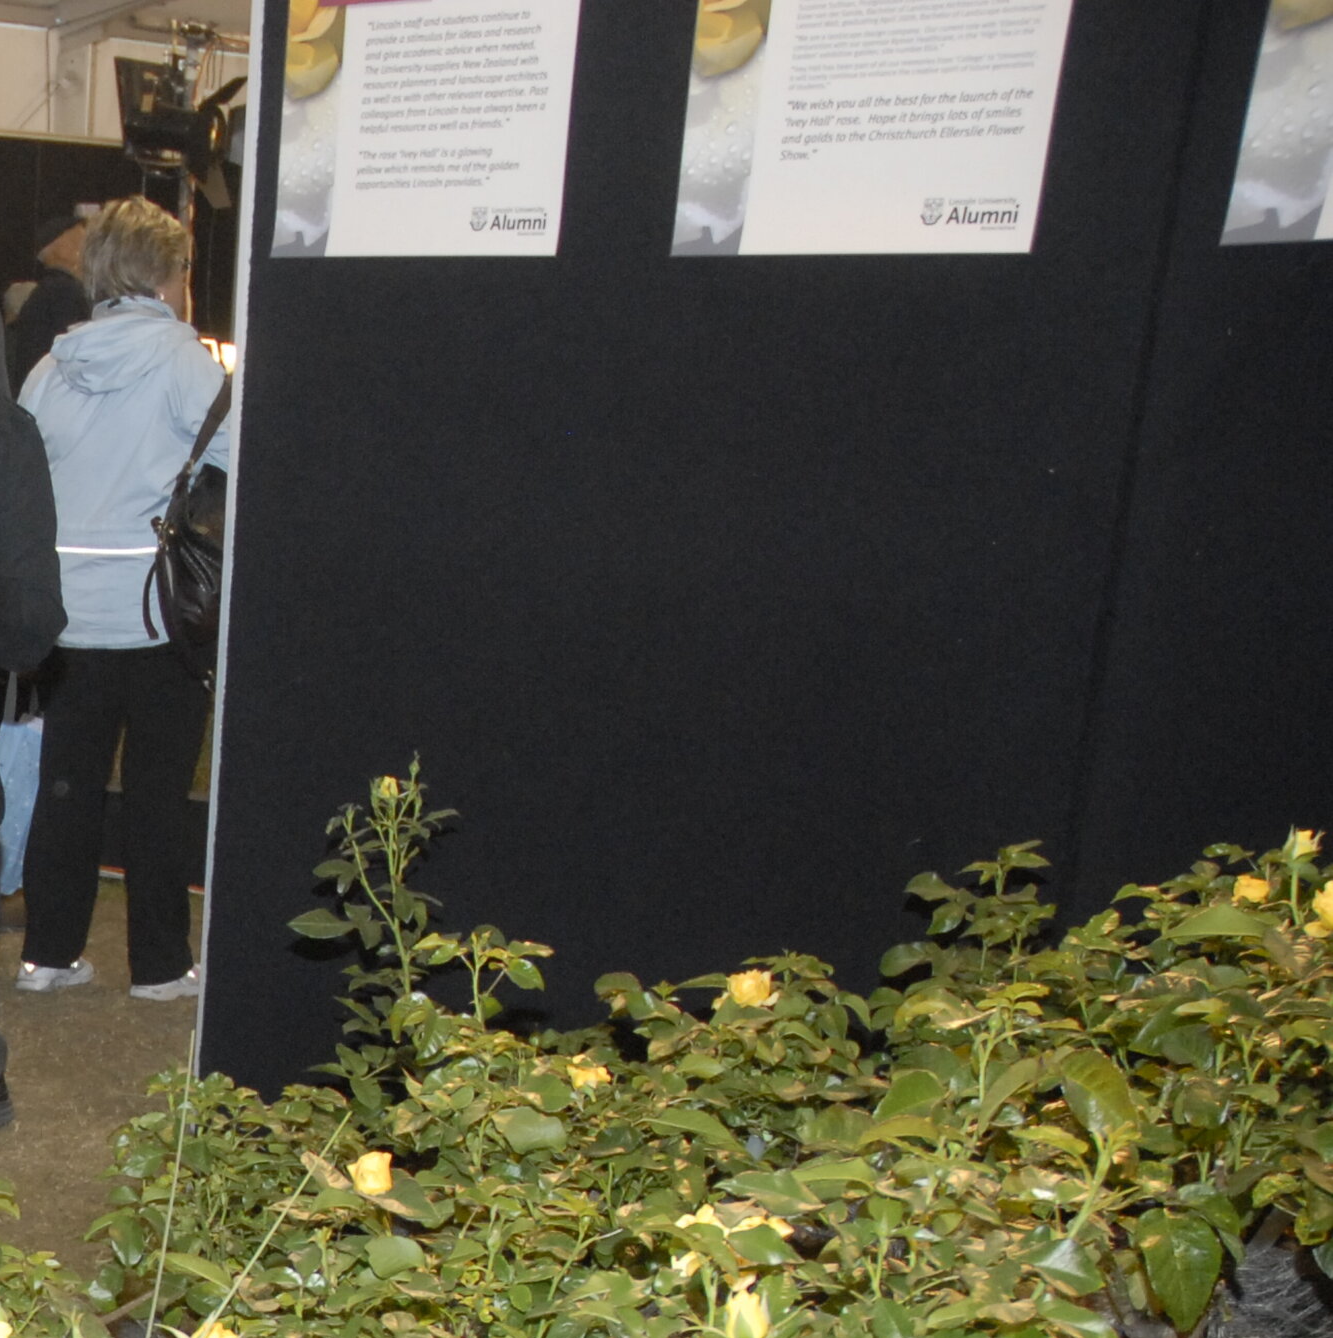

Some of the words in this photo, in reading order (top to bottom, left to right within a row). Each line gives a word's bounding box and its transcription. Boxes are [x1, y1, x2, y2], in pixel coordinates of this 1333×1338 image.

[404, 16, 422, 29] staff
[423, 16, 440, 27] and
[442, 14, 479, 26] students
[481, 11, 519, 24] continue
[521, 10, 530, 20] to
[366, 33, 397, 47] provide
[399, 35, 405, 43] a
[406, 30, 443, 43] stimulus
[444, 28, 457, 42] for
[459, 29, 482, 39] ideas
[484, 26, 502, 38] and
[503, 24, 542, 36] research
[365, 48, 381, 60] and
[383, 50, 401, 62] give
[402, 46, 441, 58] academic
[444, 44, 473, 56] advice
[475, 42, 498, 53] when
[365, 65, 378, 75] The
[380, 62, 422, 75] University
[424, 60, 460, 73] supplies
[462, 60, 482, 70] New
[482, 56, 518, 69] Zealand
[520, 54, 539, 65] with
[363, 80, 399, 90] resource
[400, 77, 437, 91] planners
[439, 74, 457, 86] and
[458, 74, 503, 86] landscape
[504, 71, 548, 82] architects
[361, 97, 371, 105] as
[373, 93, 390, 104] well
[391, 95, 402, 104] as
[403, 91, 422, 102] with
[422, 90, 447, 101] other
[446, 89, 483, 101] relevant
[484, 86, 527, 100] expertise.
[529, 85, 549, 97] Past
[809, 98, 834, 110] wish
[836, 100, 856, 112] you
[858, 97, 872, 108] all
[874, 96, 892, 107] the
[894, 95, 918, 106] best
[918, 93, 936, 108] for
[938, 92, 957, 104] the
[959, 91, 998, 104] launch
[1000, 88, 1015, 104] of
[1015, 88, 1034, 100] the
[360, 108, 404, 121] colleagues
[405, 106, 426, 120] from
[427, 105, 460, 117] Lincoln
[460, 104, 483, 115] have
[483, 103, 514, 115] always
[515, 102, 539, 113] been
[539, 103, 546, 111] a
[868, 113, 897, 126] Hope
[899, 111, 908, 123] it
[909, 109, 945, 125] brings
[947, 109, 968, 120] lots
[970, 107, 986, 122] of
[986, 107, 1022, 118] smiles
[359, 121, 389, 134] helpful
[389, 124, 427, 133] resource
[428, 123, 439, 131] as
[439, 119, 458, 130] well
[459, 121, 470, 130] as
[781, 132, 801, 144] and
[835, 133, 846, 143] to
[848, 131, 866, 142] the
[867, 128, 937, 141] Christchurch
[939, 126, 984, 138] Ellerslie
[986, 124, 1025, 136] Flower
[378, 151, 396, 160] rose
[441, 148, 449, 157] is
[450, 149, 457, 157] a
[458, 147, 493, 160] glowing
[356, 165, 382, 177] yellow
[384, 163, 409, 174] which
[411, 162, 445, 173] reminds
[447, 163, 460, 172] me
[462, 161, 473, 173] of
[473, 161, 486, 171] the
[488, 160, 520, 172] golden
[355, 178, 410, 190] opportunities
[412, 177, 444, 188] Lincoln
[489, 212, 548, 231] Alumni
[946, 204, 1020, 224] Alumni
